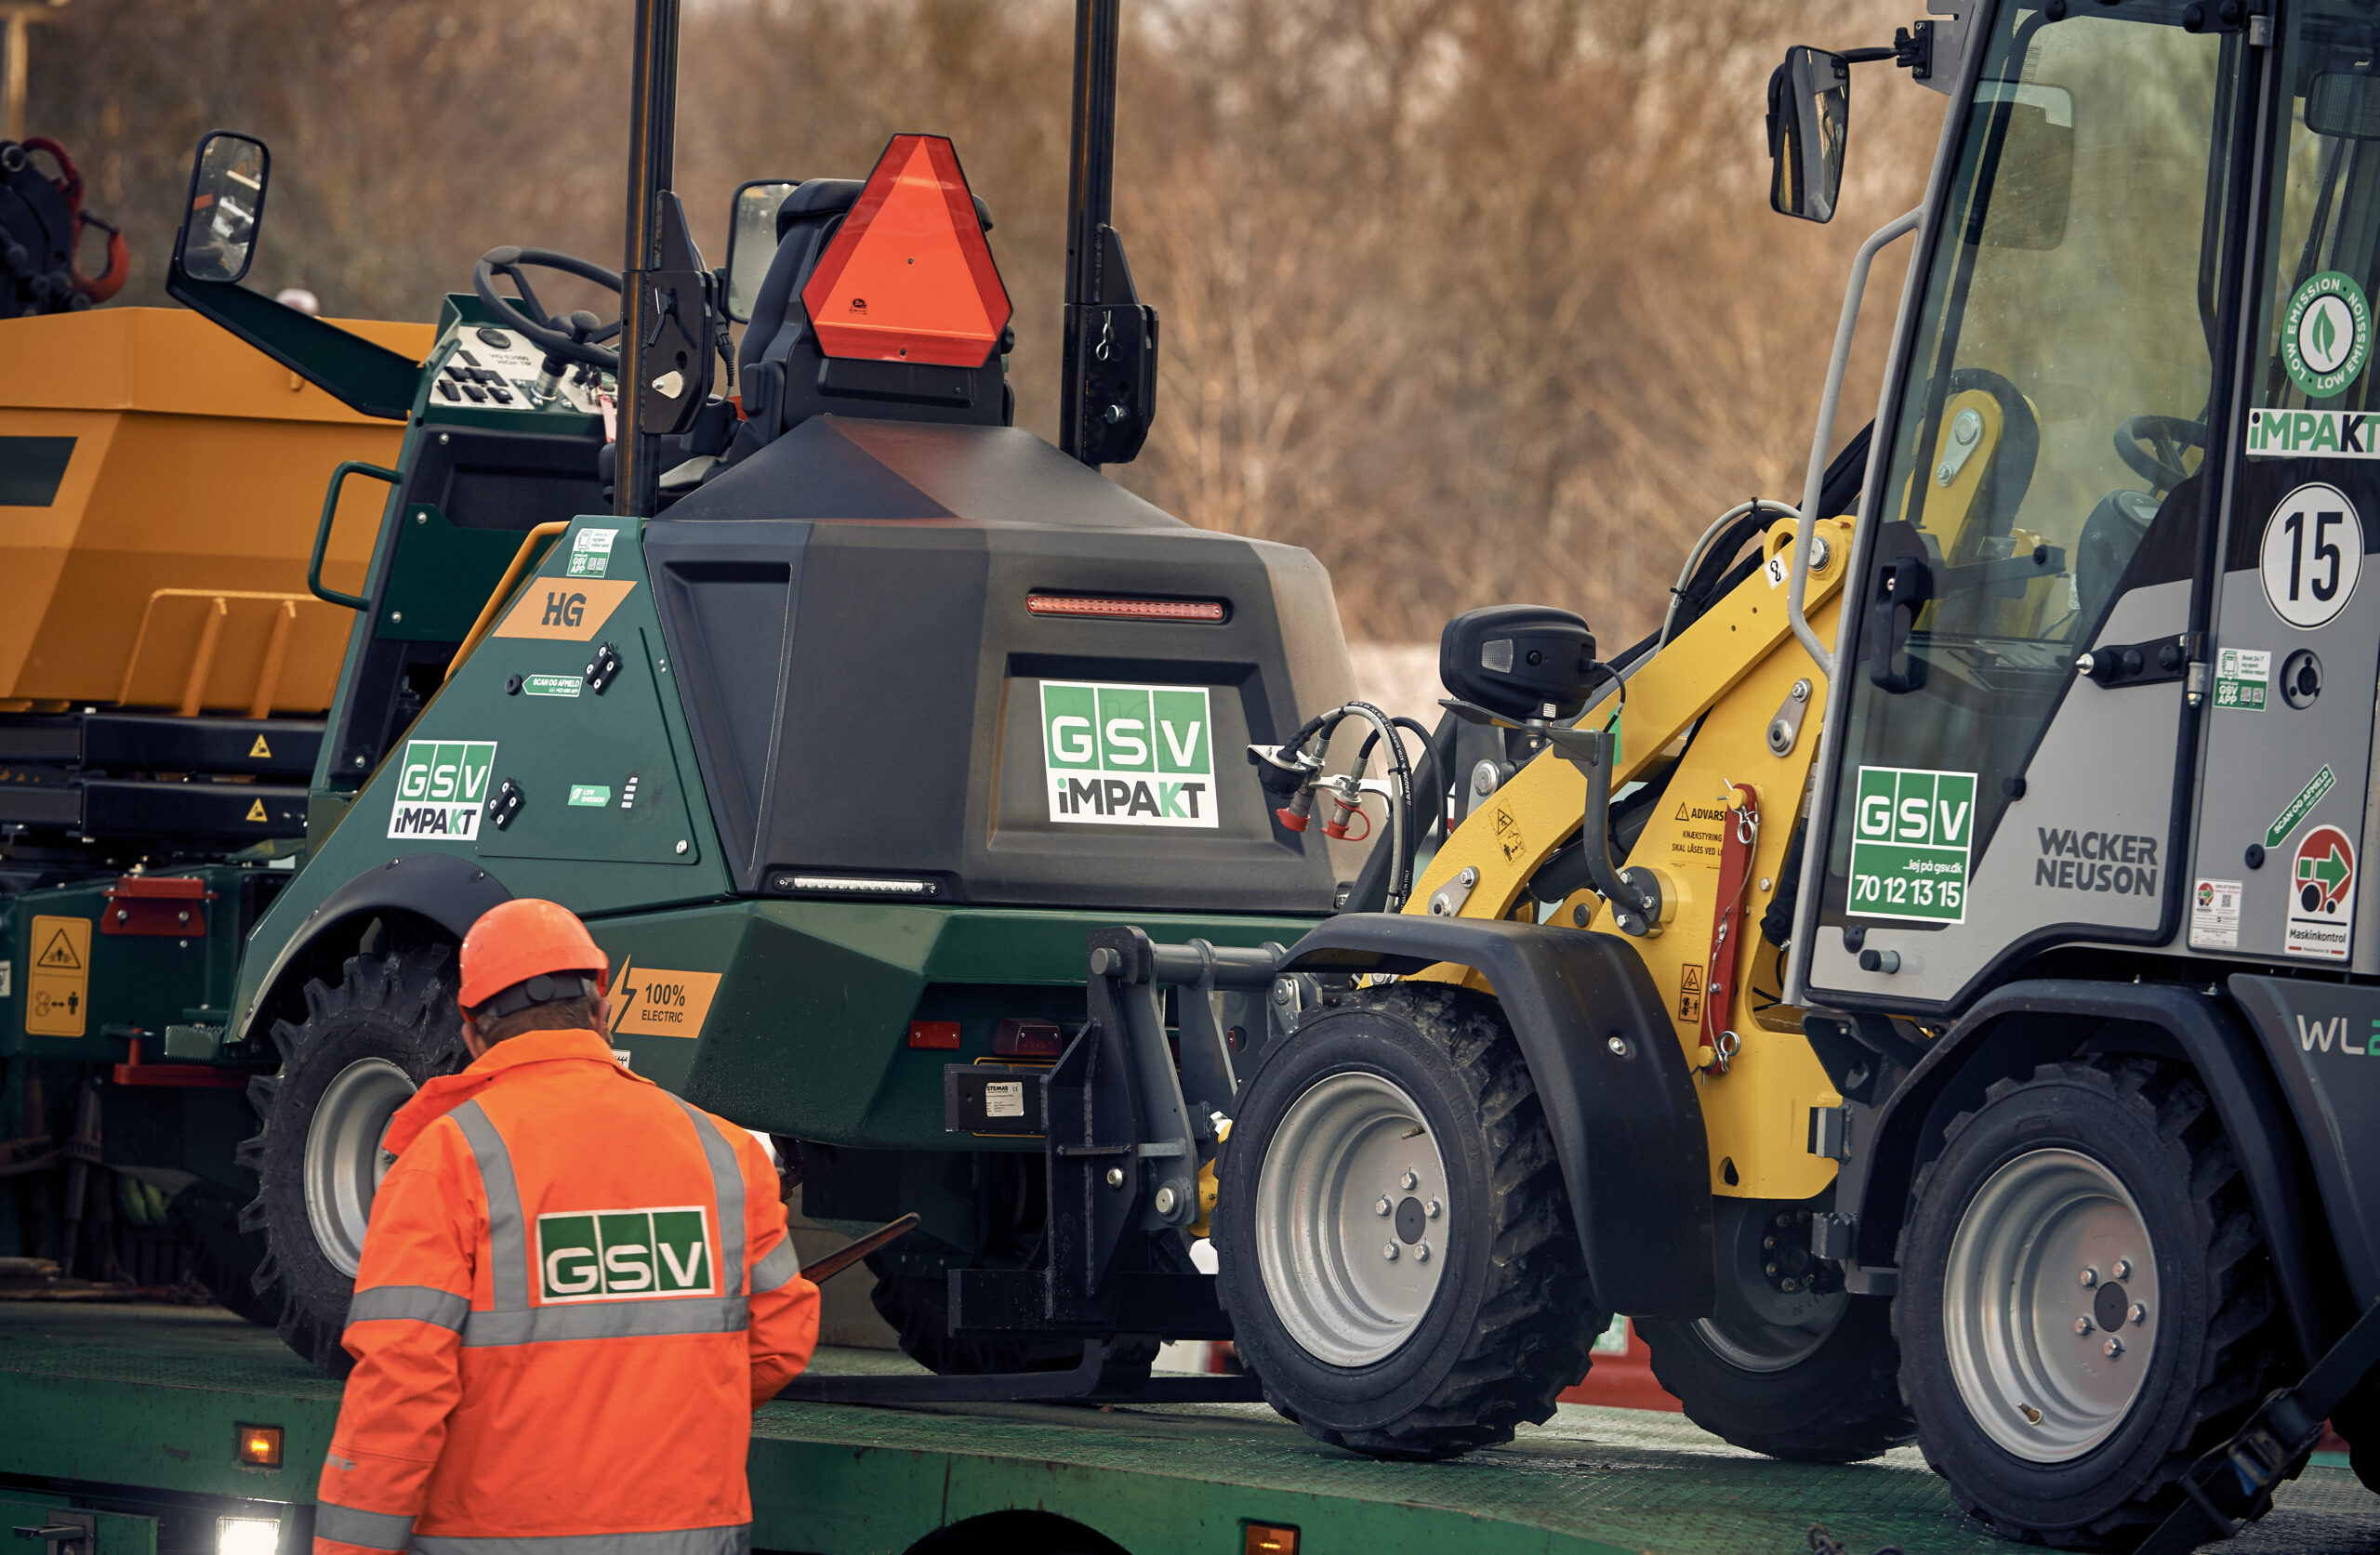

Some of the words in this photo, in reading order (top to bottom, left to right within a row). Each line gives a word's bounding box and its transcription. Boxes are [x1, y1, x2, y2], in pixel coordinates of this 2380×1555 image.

[2287, 278, 2341, 336] EMISSION
[2316, 370, 2346, 390] LOW
[2345, 291, 2367, 375] EMISSION
[2286, 342, 2307, 381] LOW
[570, 565, 586, 573] APP
[2284, 511, 2344, 601] 15
[541, 592, 587, 627] HG
[533, 678, 549, 687] SCAN
[558, 679, 580, 688] AFMELD
[2216, 694, 2238, 705] APP
[2218, 685, 2240, 695] GSV
[1051, 715, 1202, 767] GSV
[402, 764, 488, 798] GSV
[580, 796, 605, 804] EMISSION
[1690, 808, 1727, 822] ADVARS
[2273, 810, 2294, 835] SCAN
[2292, 798, 2304, 813] OG
[2302, 771, 2329, 803] AFMELD
[1860, 795, 1969, 841] GSV
[1672, 843, 1686, 852] SKAL
[1686, 843, 1703, 854] LÅSES
[1704, 847, 1716, 855] VED
[1682, 830, 1723, 842] KNÆKSTYRING
[2037, 826, 2158, 866] WACKER
[1921, 860, 1933, 874] på
[1933, 862, 1964, 875] gsv.dk
[2034, 858, 2157, 897] NEUSON
[1855, 875, 1881, 902] 70
[1883, 876, 1907, 904] 12
[1910, 878, 1935, 906] 13
[1937, 880, 1962, 908] 15
[2289, 928, 2347, 943] Maskinkontrol
[645, 982, 686, 1008] 100%
[641, 1009, 683, 1024] ELECTRIC
[546, 1241, 704, 1294] GSV
